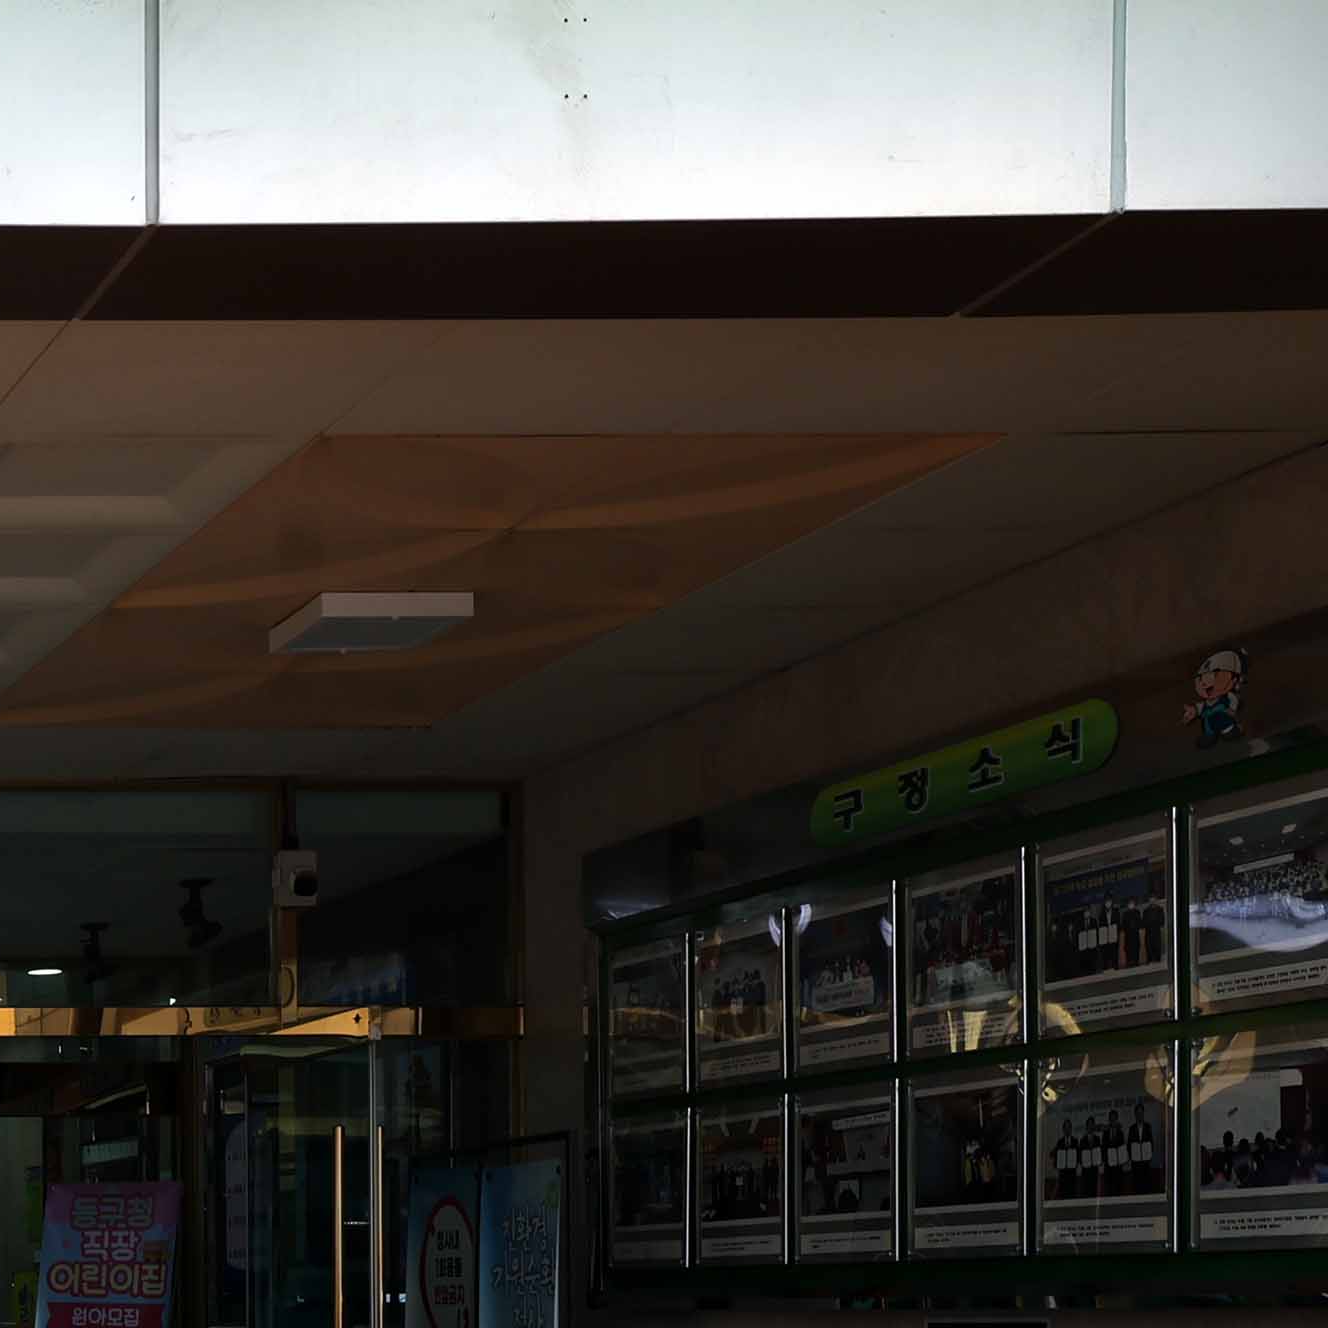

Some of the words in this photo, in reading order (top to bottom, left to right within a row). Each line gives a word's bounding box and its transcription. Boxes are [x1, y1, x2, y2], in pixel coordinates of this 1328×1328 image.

[832, 715, 1085, 832] 구정소식
[81, 1230, 141, 1263] 직장
[47, 1262, 167, 1298] 어린이집
[70, 1306, 141, 1328] 원아모집
